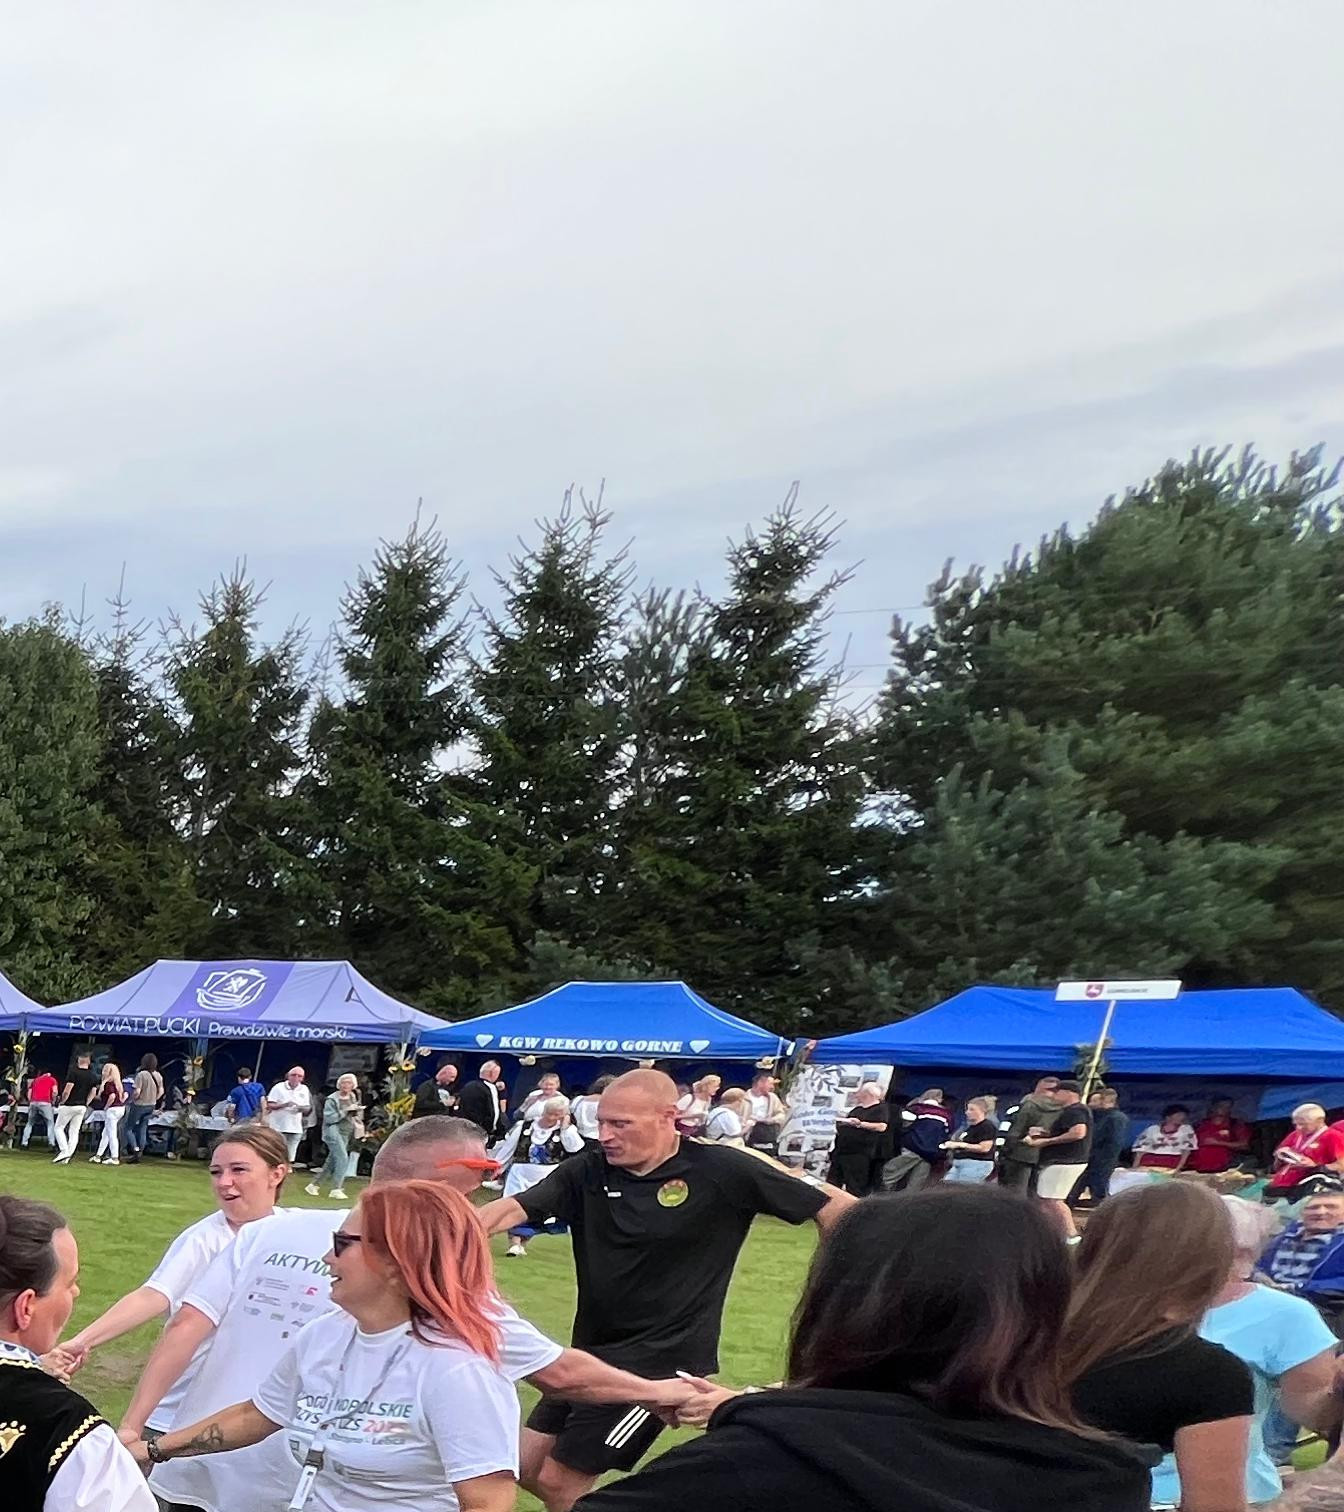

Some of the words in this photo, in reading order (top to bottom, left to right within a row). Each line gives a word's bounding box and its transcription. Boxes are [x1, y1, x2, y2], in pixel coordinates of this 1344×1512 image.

[69, 1014, 146, 1033] POWIAT
[144, 1017, 201, 1035] PUCKI
[207, 1021, 290, 1038] Prawdziwie
[499, 1036, 541, 1049] KGW
[542, 1037, 619, 1052] REKOWO
